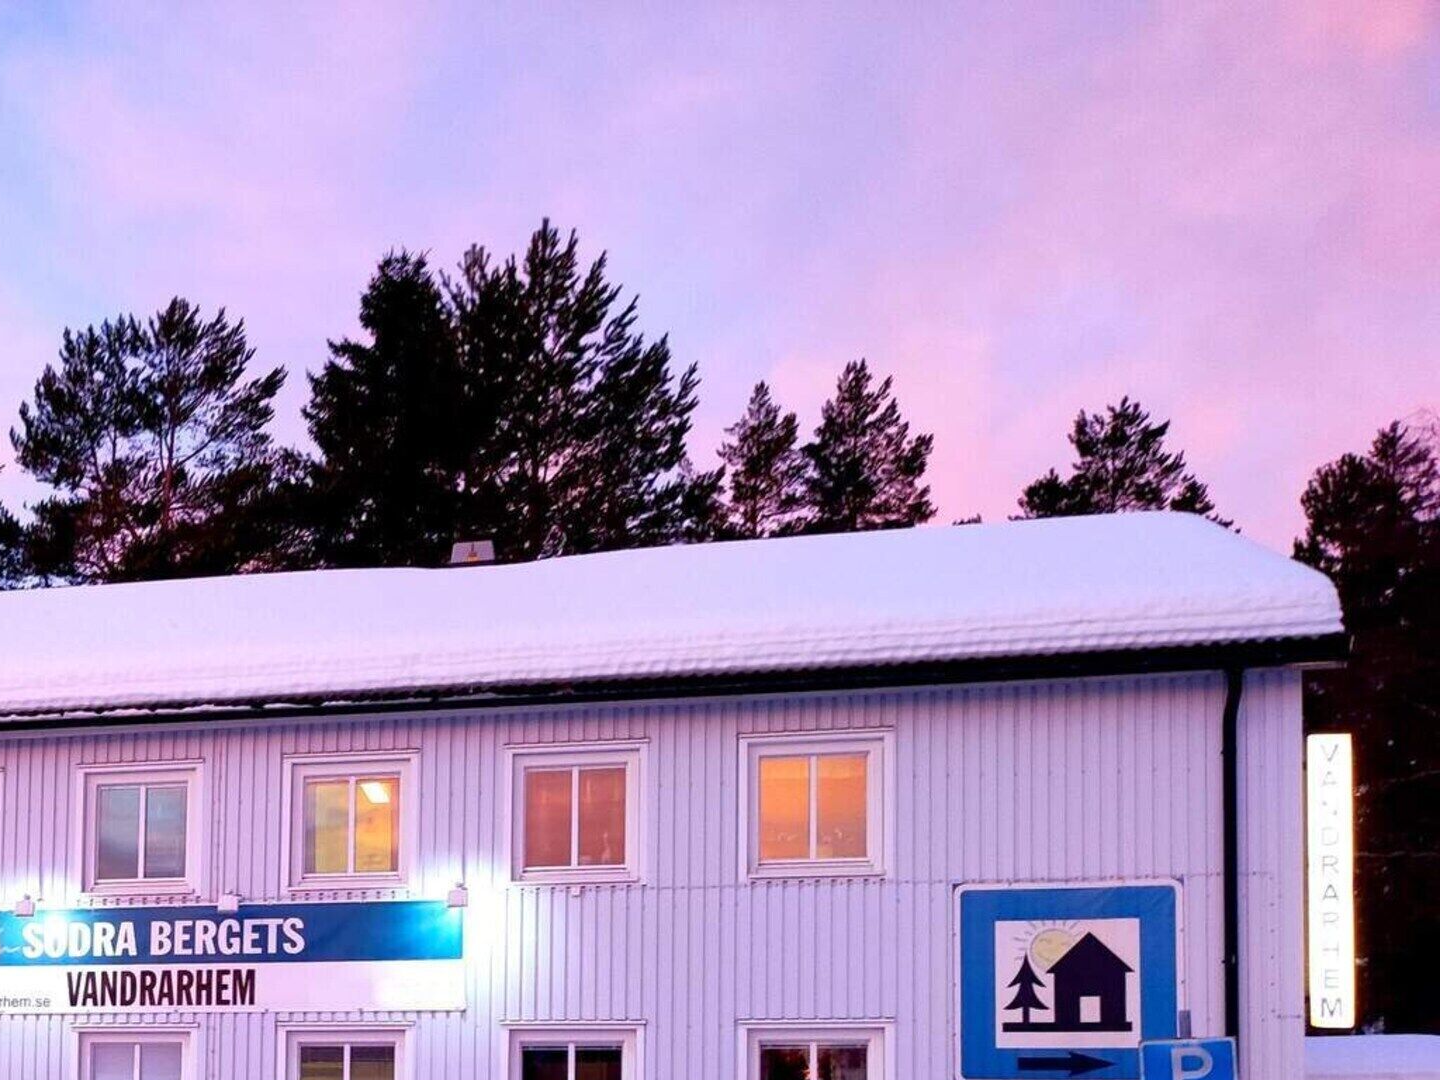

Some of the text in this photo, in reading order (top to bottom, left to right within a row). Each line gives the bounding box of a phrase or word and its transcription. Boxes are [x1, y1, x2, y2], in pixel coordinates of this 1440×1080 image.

[1320, 743, 1343, 1018] VADRARHEM
[149, 917, 306, 956] BERGETS
[66, 968, 257, 1007] VANDRARHEM
